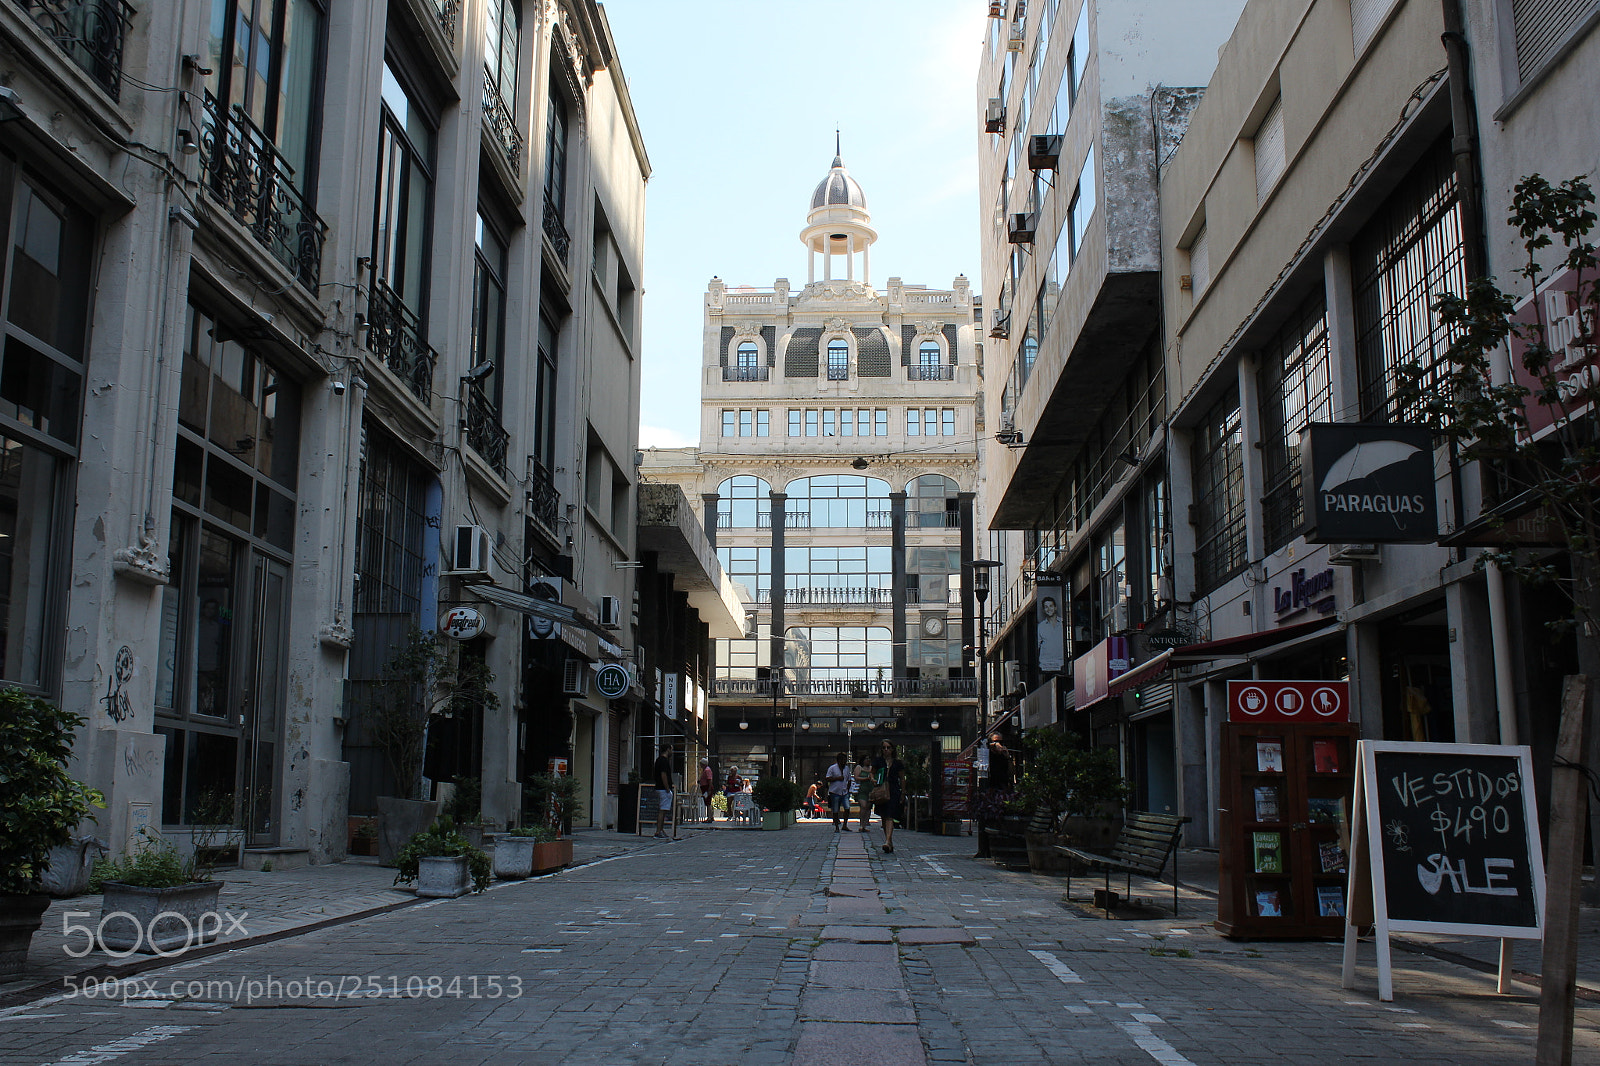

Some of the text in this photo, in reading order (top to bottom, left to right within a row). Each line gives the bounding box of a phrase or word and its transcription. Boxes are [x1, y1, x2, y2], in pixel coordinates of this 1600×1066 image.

[1324, 493, 1425, 514] PARAGUAS
[1149, 637, 1188, 645] ANTIQUES
[603, 673, 620, 686] HA
[1430, 802, 1510, 851] $490
[1417, 853, 1518, 896] SALE
